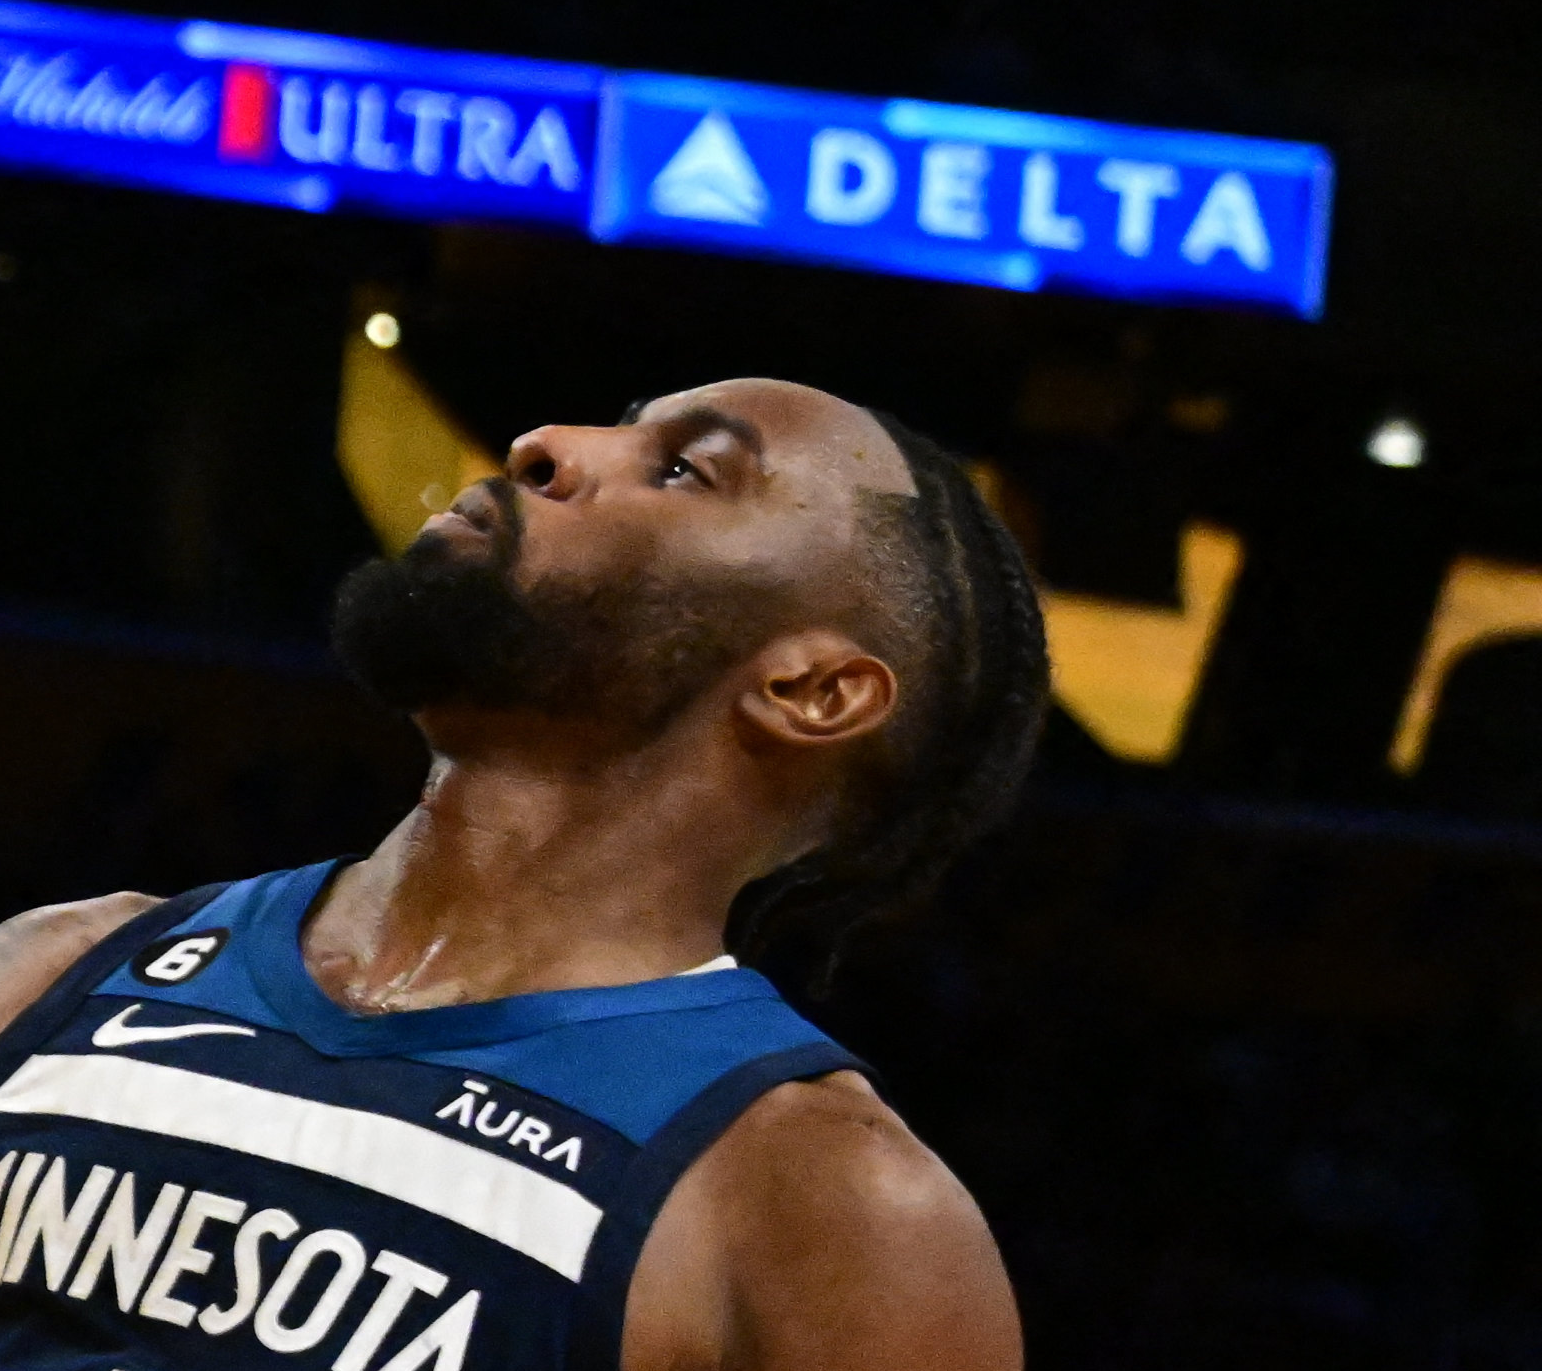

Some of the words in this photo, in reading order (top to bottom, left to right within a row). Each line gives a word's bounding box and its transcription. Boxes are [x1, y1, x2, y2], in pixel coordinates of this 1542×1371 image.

[278, 75, 580, 191] ULTRA
[805, 126, 1273, 272] DELTA
[144, 935, 218, 981] 6
